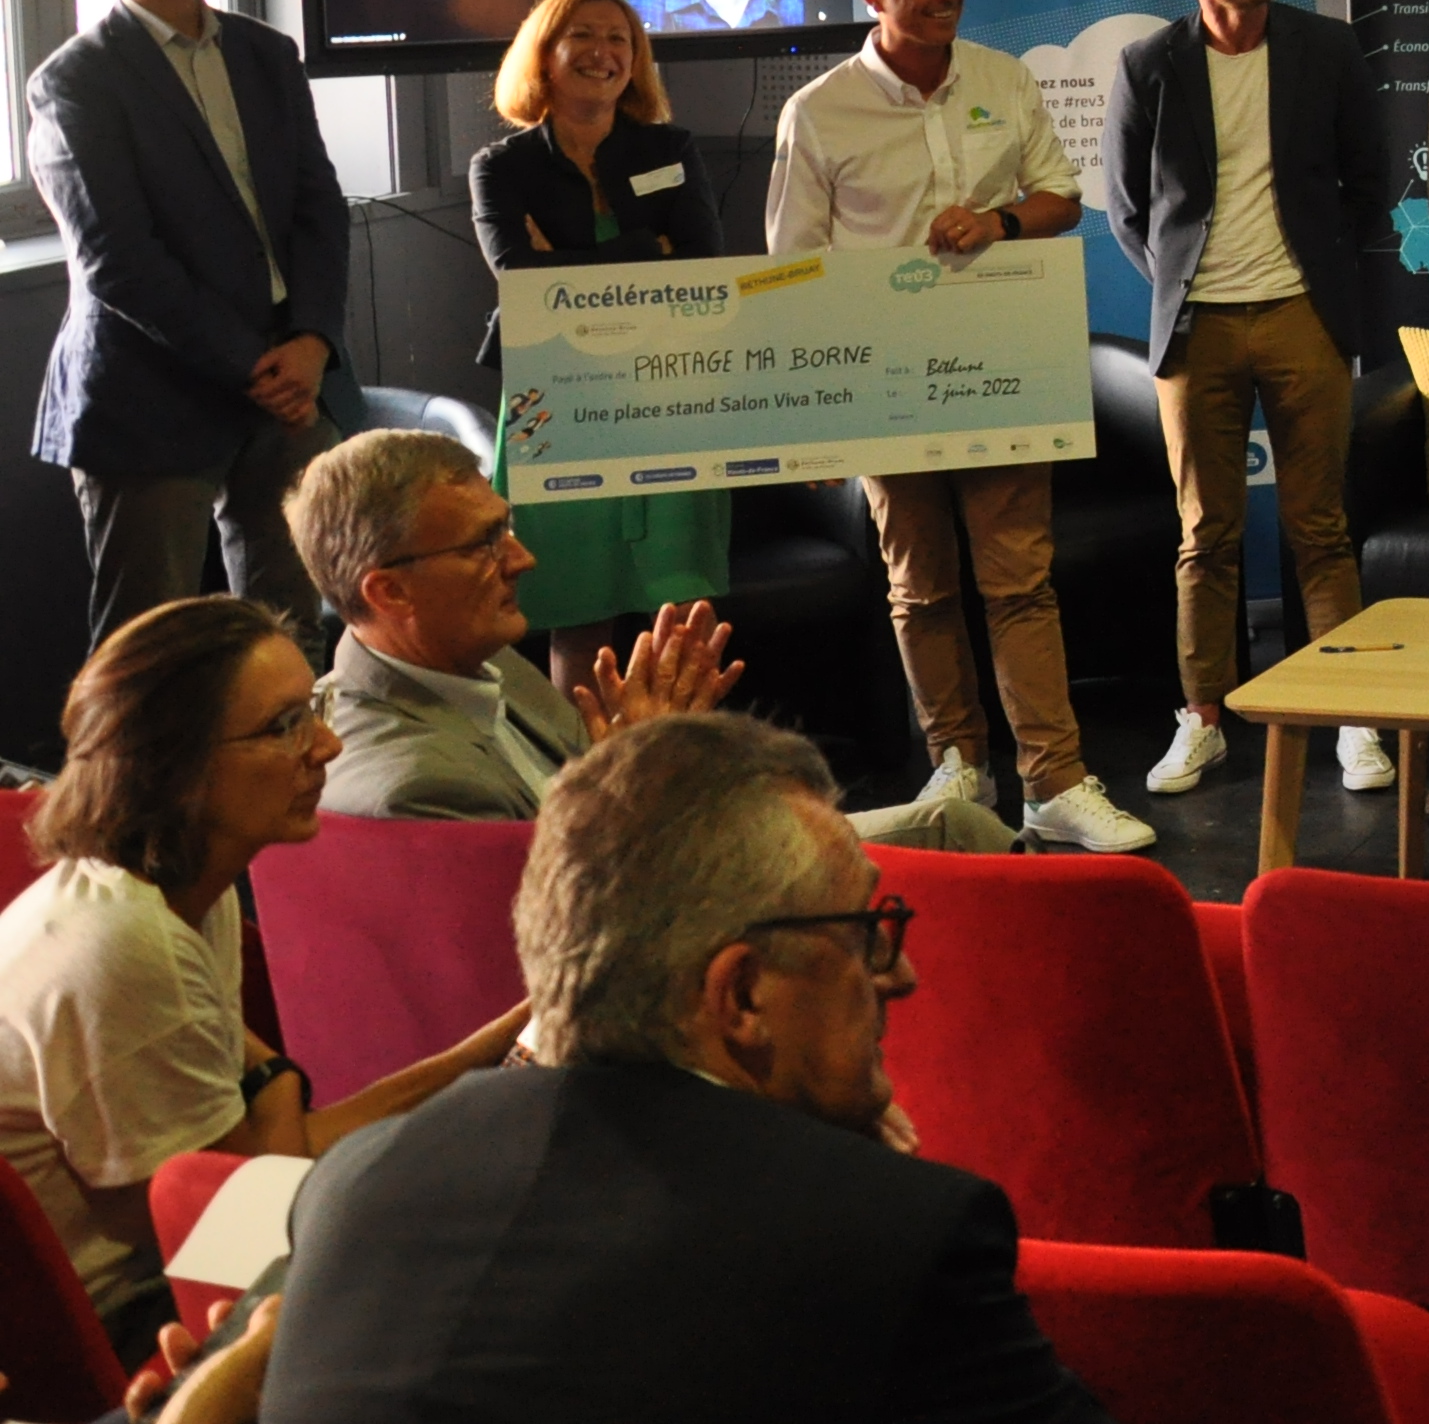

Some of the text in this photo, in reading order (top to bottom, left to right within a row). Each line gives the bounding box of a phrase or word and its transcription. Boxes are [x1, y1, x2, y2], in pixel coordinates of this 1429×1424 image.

[1060, 77, 1096, 89] nous
[1063, 94, 1106, 109] #rev3
[1059, 114, 1077, 129] de
[1080, 114, 1105, 128] bra
[1080, 137, 1099, 148] en
[551, 282, 729, 311] Accélérateurs
[634, 349, 734, 382] PARTAGE
[745, 346, 776, 372] MA
[788, 344, 873, 372] BORNE
[926, 377, 1021, 405] 2 juin 2022
[573, 387, 854, 424] Une place stand Salon Viva Tech
